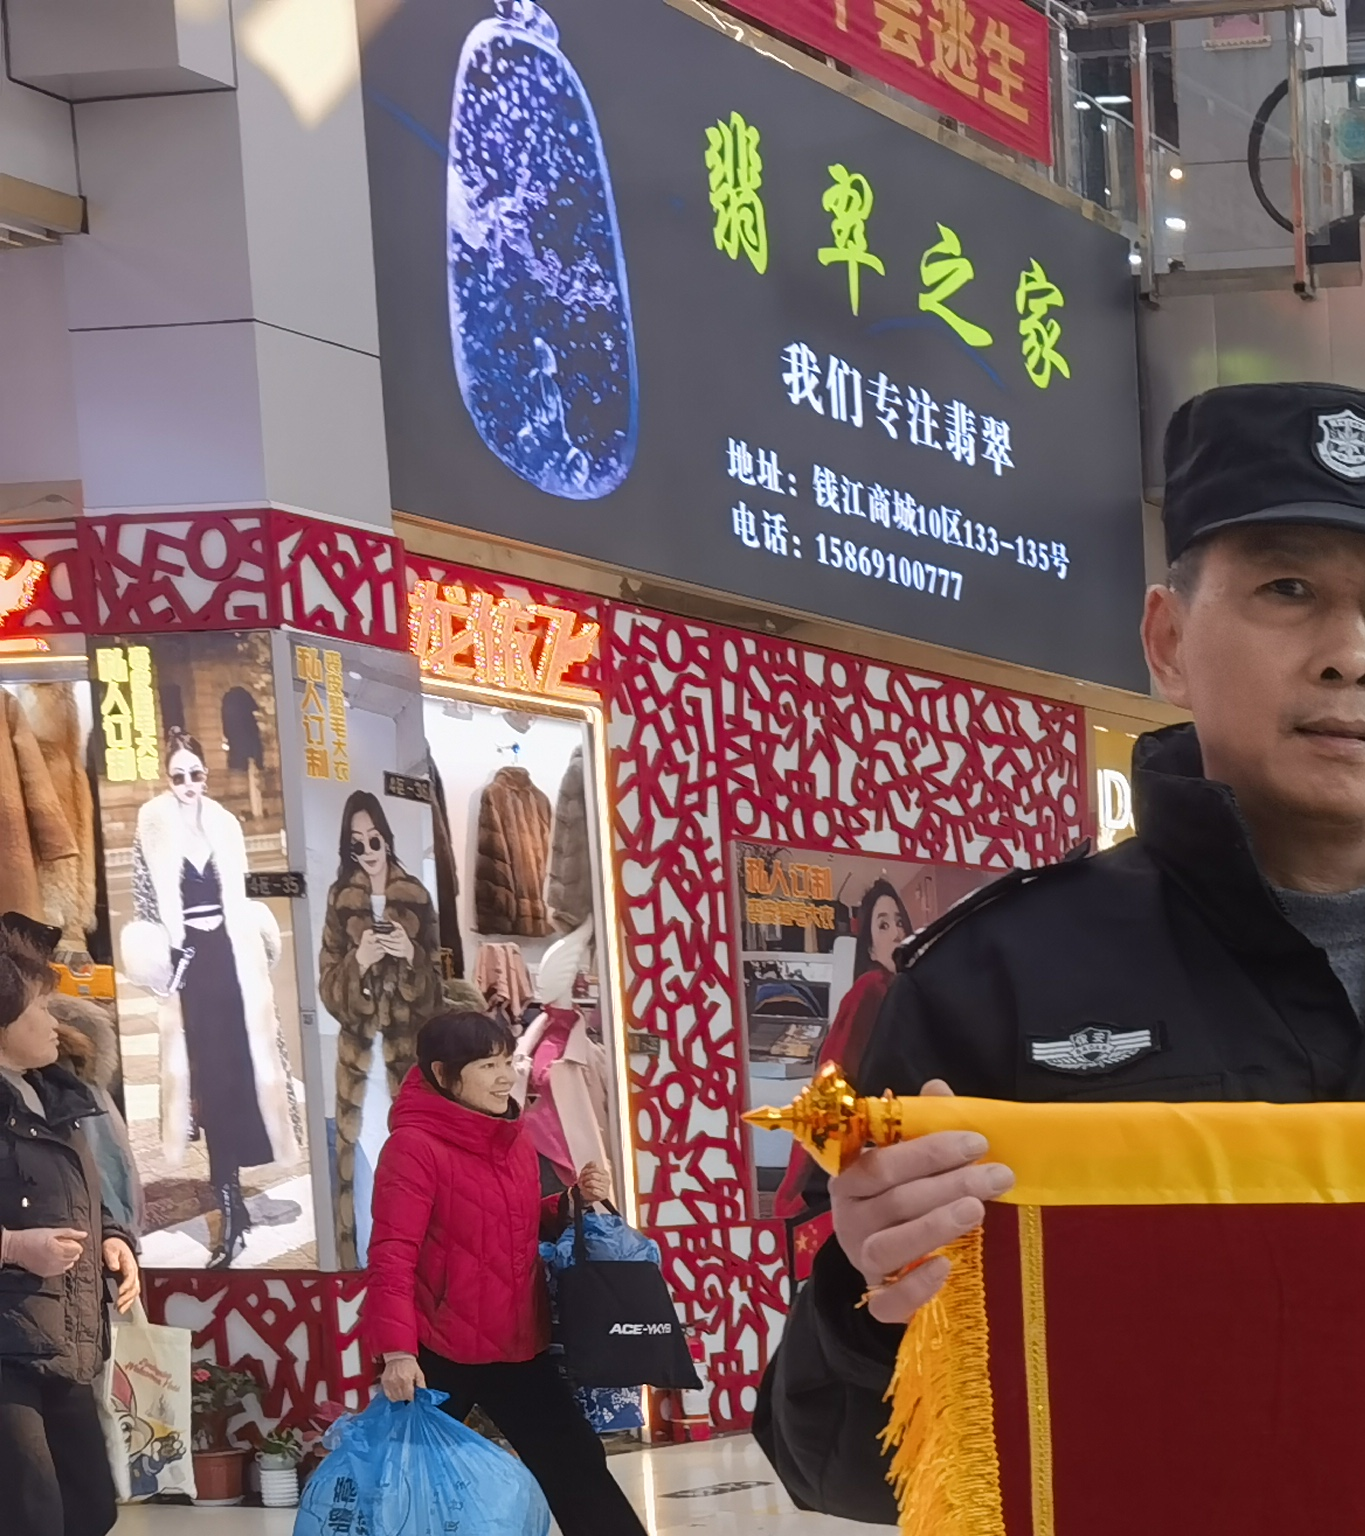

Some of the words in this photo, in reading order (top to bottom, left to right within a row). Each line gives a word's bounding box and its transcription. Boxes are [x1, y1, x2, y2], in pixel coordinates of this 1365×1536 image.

[835, 0, 1030, 124] 会逃生
[703, 111, 1071, 388] 翡翠之家
[780, 341, 1014, 476] 我们专注翡翠
[295, 646, 330, 780] 私人订制
